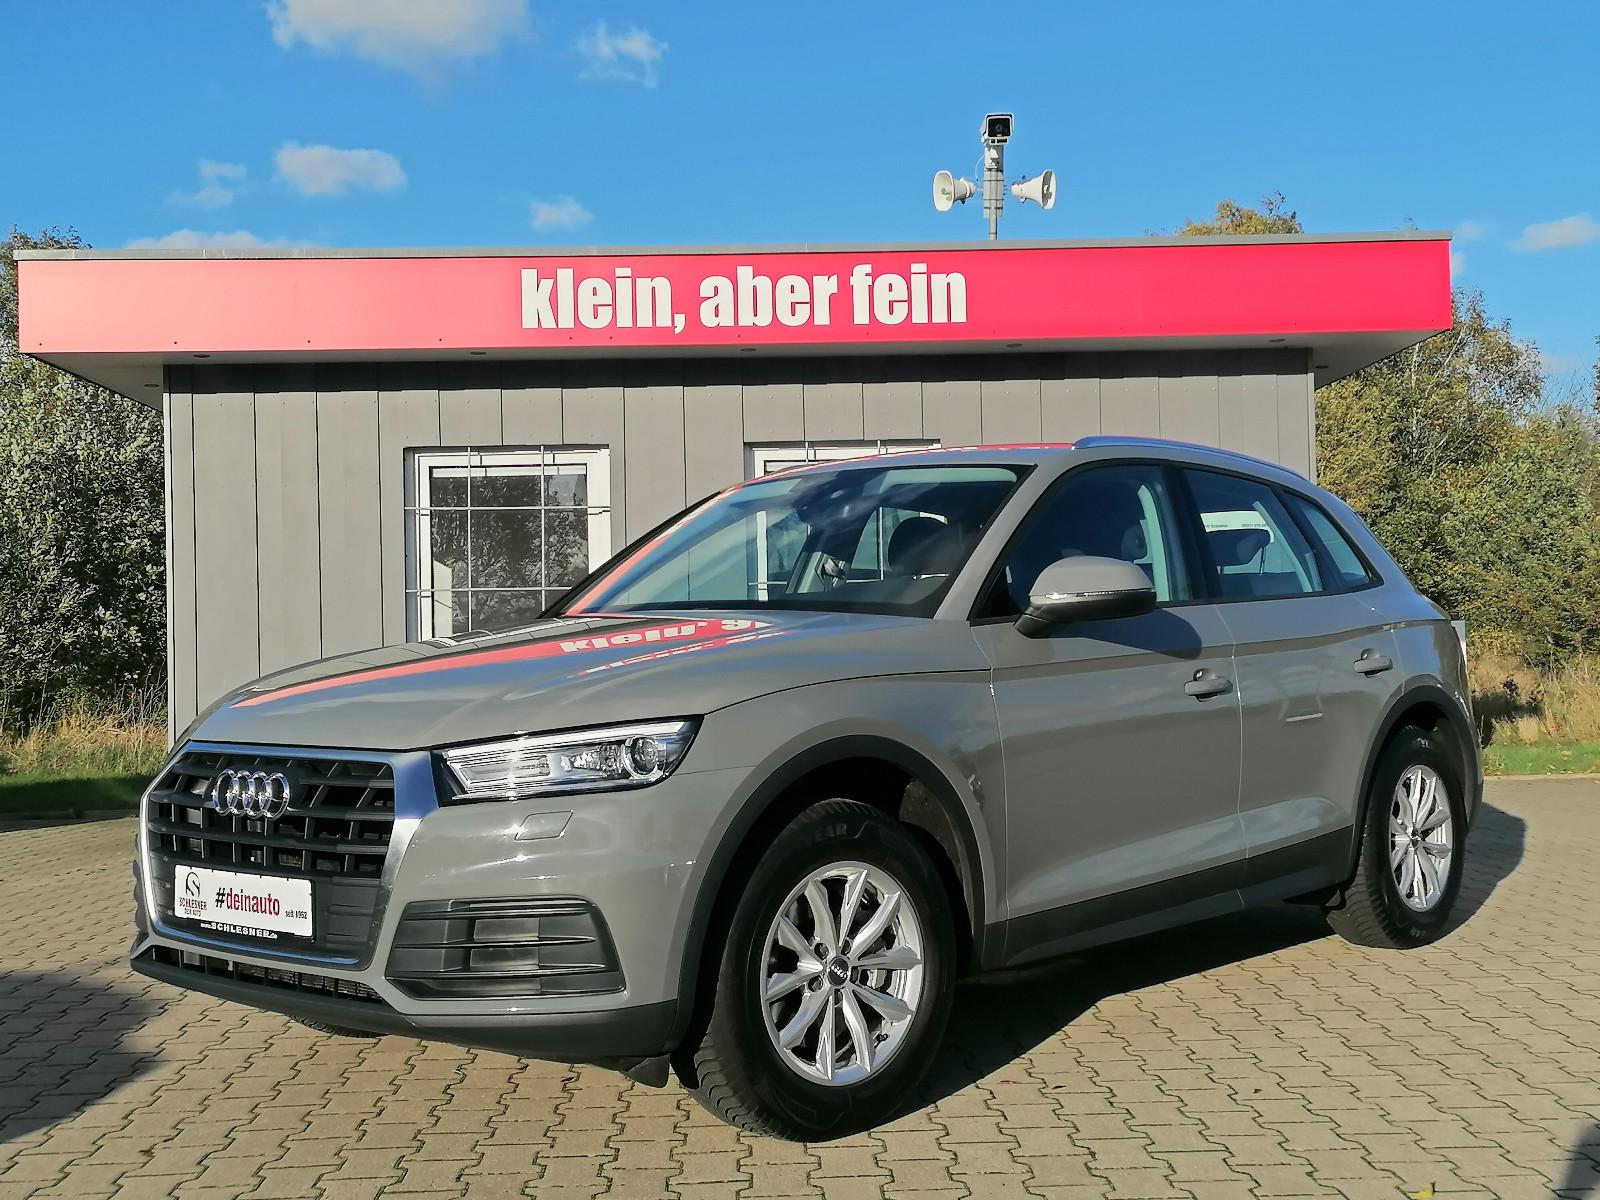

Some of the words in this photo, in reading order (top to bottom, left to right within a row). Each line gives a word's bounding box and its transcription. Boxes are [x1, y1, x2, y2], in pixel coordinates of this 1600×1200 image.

[520, 267, 687, 335] klein,
[699, 265, 838, 328] aber
[850, 263, 968, 325] fein
[179, 896, 207, 911] SCHLESNER
[214, 887, 281, 917] #deinauto
